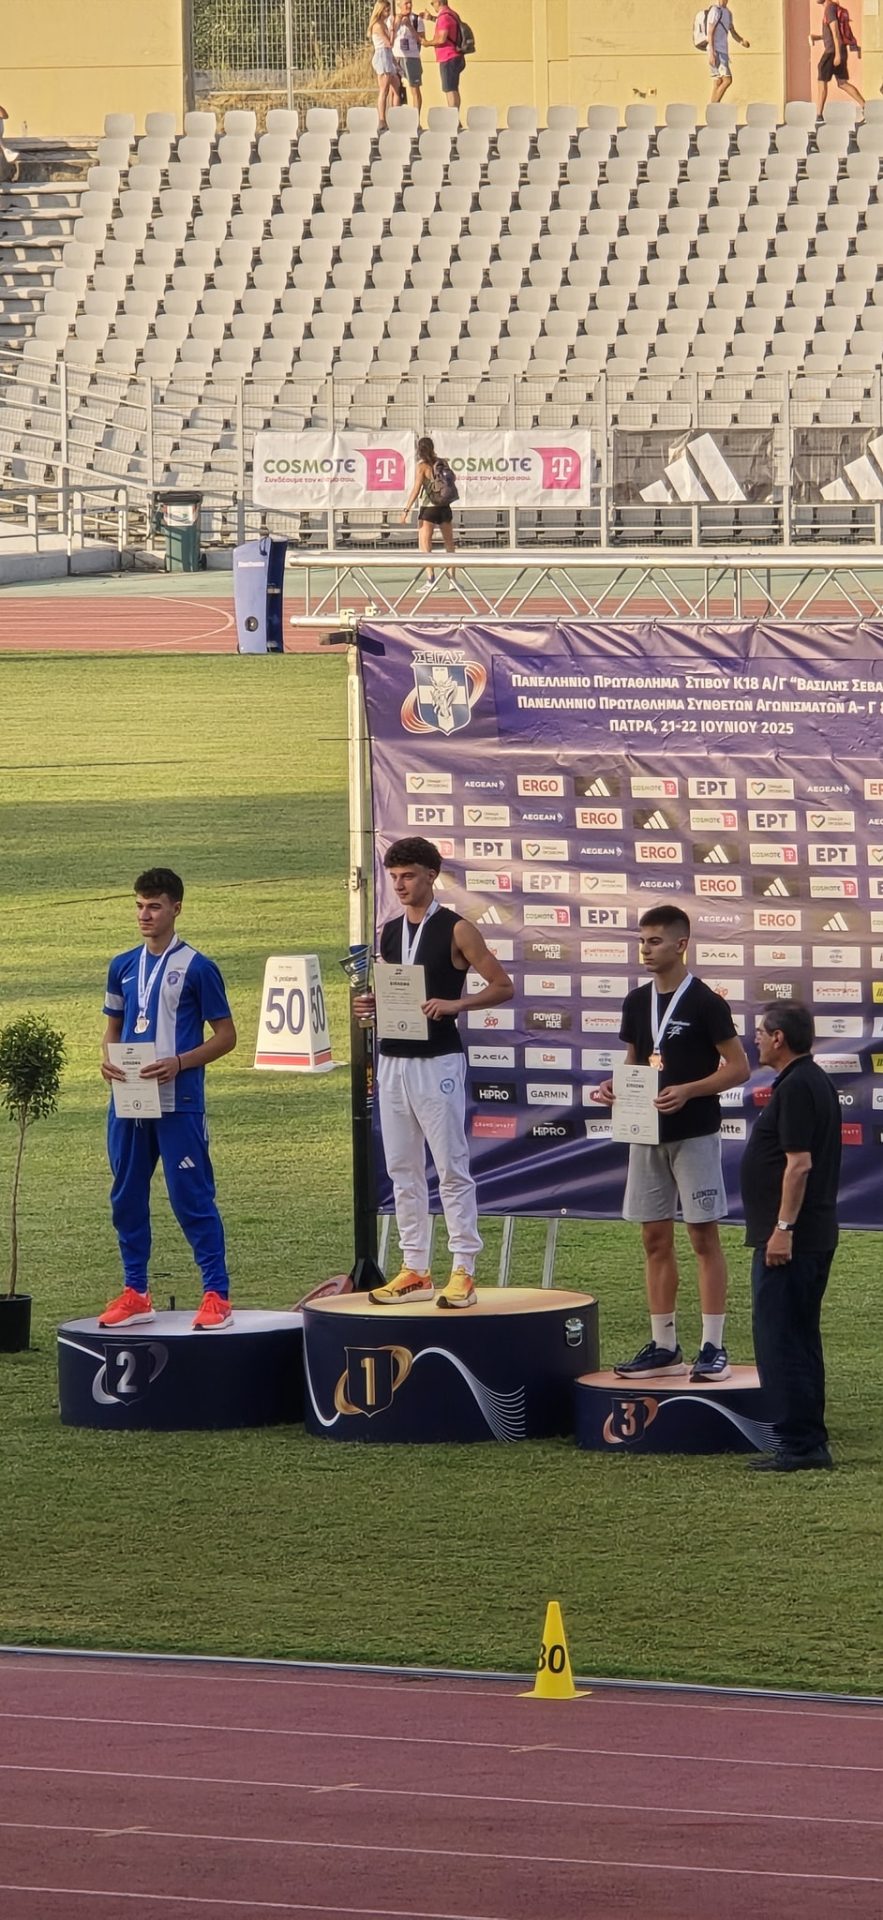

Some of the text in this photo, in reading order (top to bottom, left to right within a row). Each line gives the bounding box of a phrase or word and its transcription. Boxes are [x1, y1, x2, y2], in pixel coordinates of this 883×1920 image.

[263, 459, 356, 474] COSMOTE
[511, 674, 591, 688] ΠΑΝΕΛΛΗΝΙΟ
[593, 675, 679, 689] ΠΡΩΤΑΘΛΗΜΑ
[685, 676, 731, 690] ΣΤΙΒΟΥ
[517, 696, 597, 709] ΠΑΝΕΛΛΗΝΙΟ
[599, 697, 685, 710] ΠΡΩΤΑΘΛΗΜΑ
[687, 698, 753, 711] ΣΥΝΘΕΤΩΝ
[756, 699, 845, 713] ΑΓΩΝΙΣΜΑΤΩΝ
[609, 719, 794, 734] ΠΑΤΡΑ, 21-22 ΙΟΥΝΙΟΥ 2025
[522, 780, 559, 792] ERGO
[581, 813, 618, 825] ERGO
[641, 847, 677, 859] ERGO
[700, 880, 736, 892] ERGO
[759, 914, 796, 926] ERGO
[532, 944, 561, 952] POWER
[764, 983, 792, 991] POWER
[265, 987, 305, 1035] 50
[310, 984, 326, 1034] 50
[533, 1013, 561, 1021] POWER
[530, 1091, 568, 1099] GARMIN
[115, 1351, 137, 1393] 2
[360, 1357, 376, 1405] 1
[620, 1402, 637, 1437] 3
